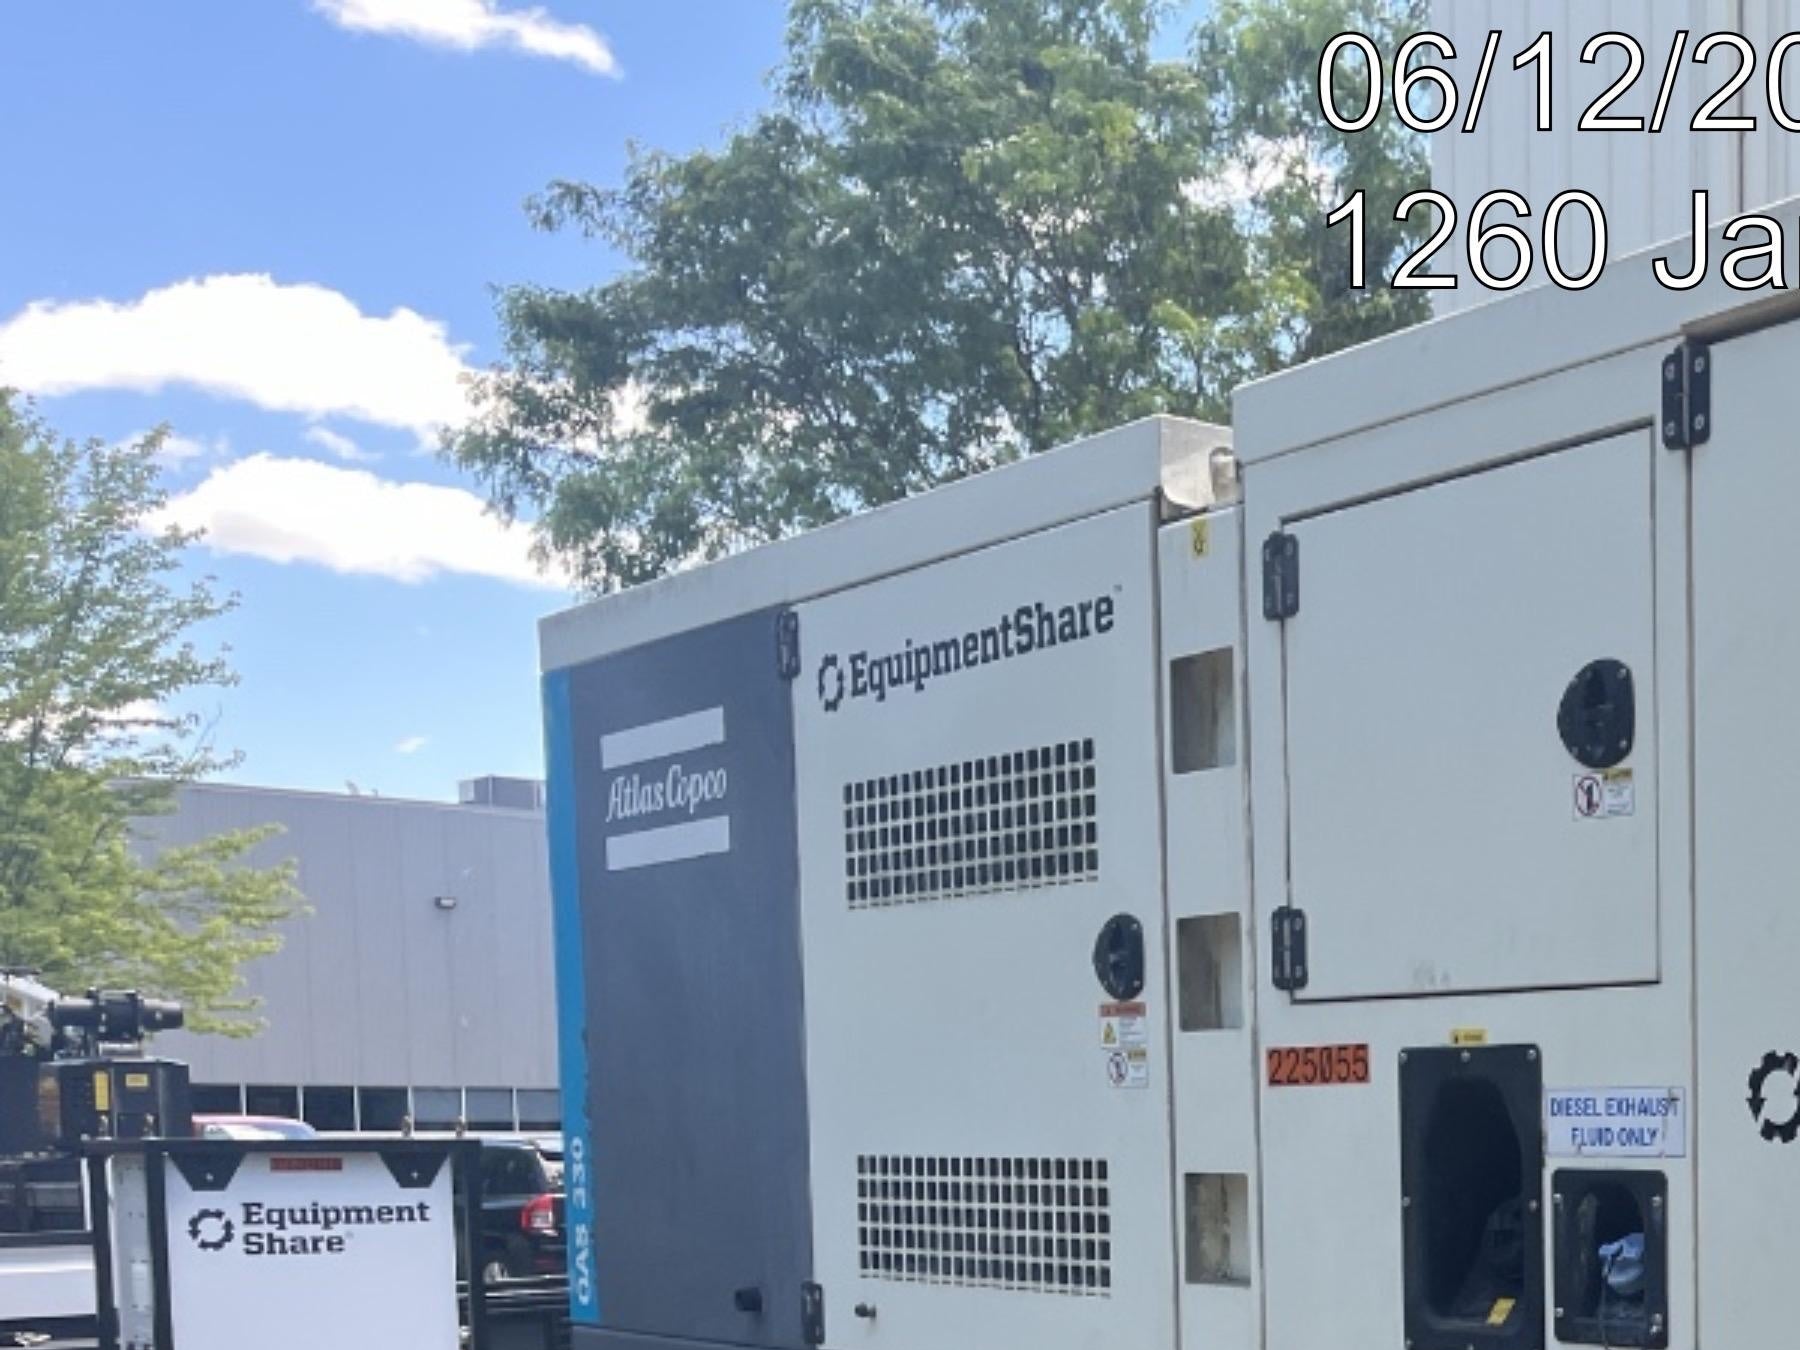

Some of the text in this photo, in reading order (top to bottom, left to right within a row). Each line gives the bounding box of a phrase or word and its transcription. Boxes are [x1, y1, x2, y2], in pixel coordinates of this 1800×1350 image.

[849, 595, 1114, 702] EquipmentShare
[605, 764, 728, 823] Atlas Copco
[1268, 1044, 1368, 1086] 225055
[1551, 1098, 1602, 1118] DIESEL
[1617, 1127, 1659, 1147] ONLY
[241, 1201, 430, 1230] Equipment
[242, 1232, 345, 1256] Share
